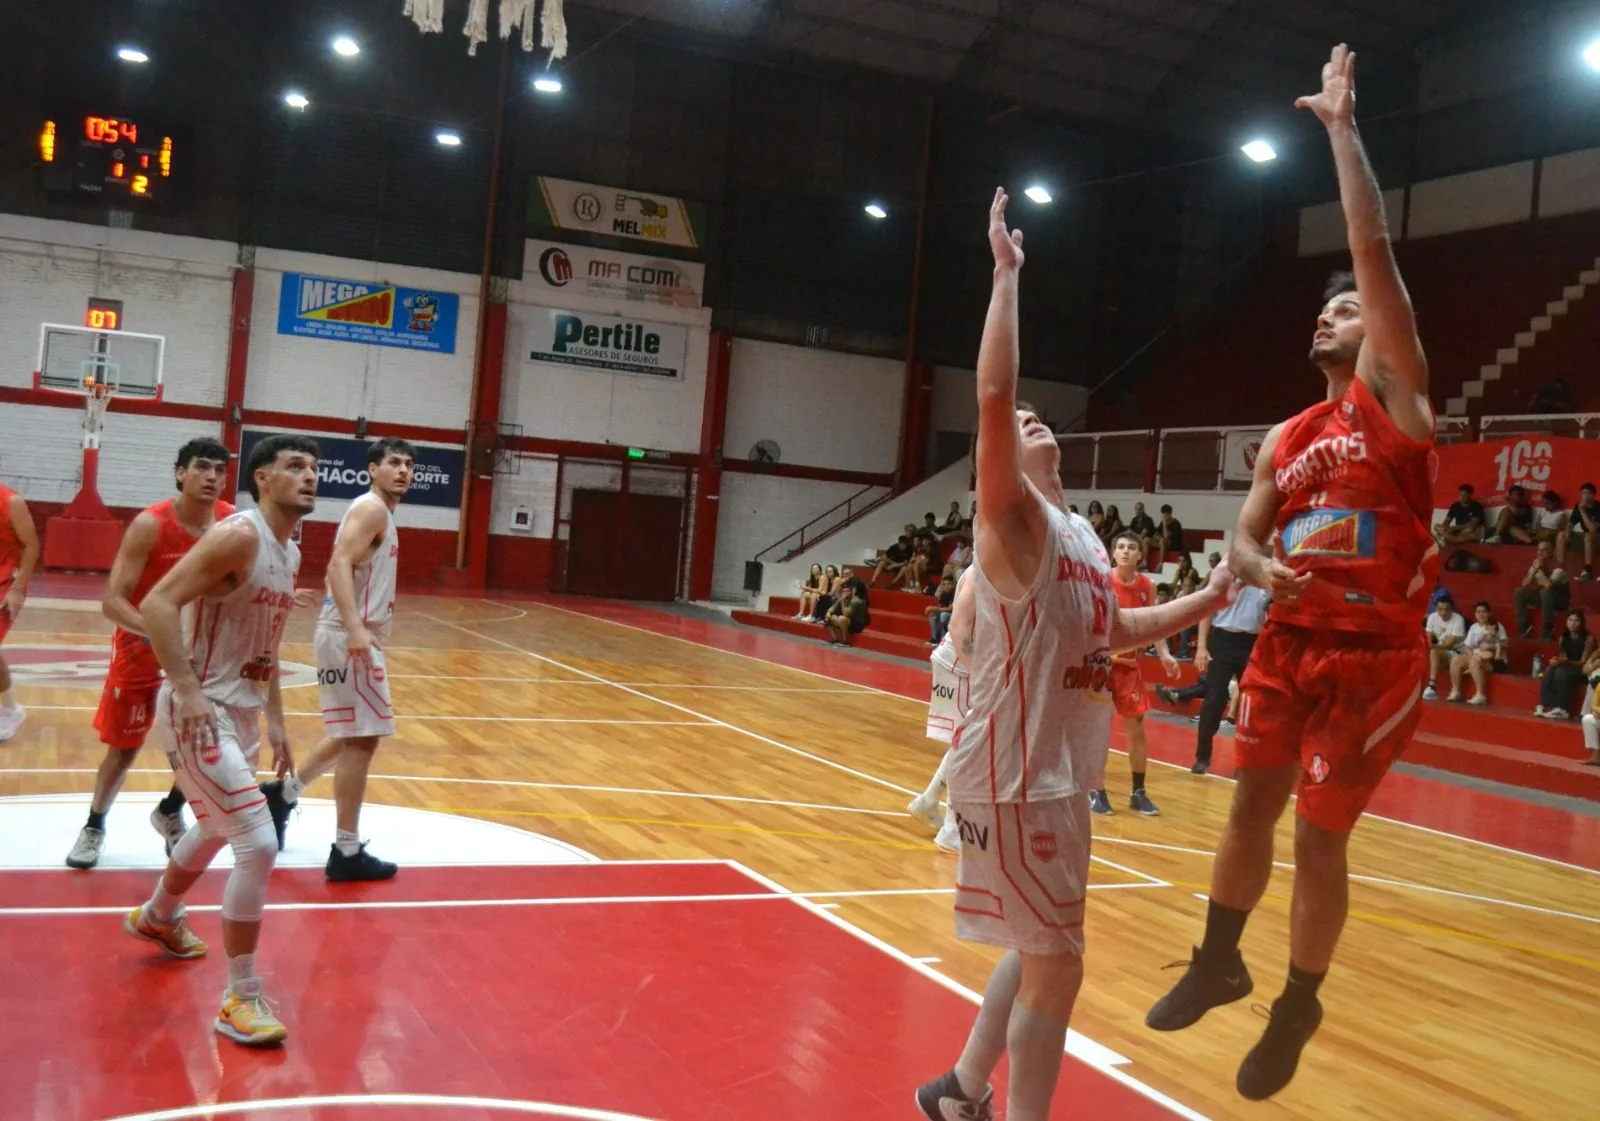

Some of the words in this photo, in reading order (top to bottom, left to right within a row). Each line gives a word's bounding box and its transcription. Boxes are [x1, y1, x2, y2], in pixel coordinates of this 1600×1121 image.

[132, 174, 149, 194] 2
[301, 279, 370, 314] MEGA
[90, 309, 117, 329] 07
[552, 314, 660, 354] Pertile
[568, 347, 609, 360] ASESORES
[610, 351, 621, 361] DE
[623, 353, 660, 366] SEGUROS
[427, 464, 442, 472] DEL
[1494, 440, 1553, 491] 100
[317, 466, 371, 487] HACO
[414, 471, 450, 484] ORTE
